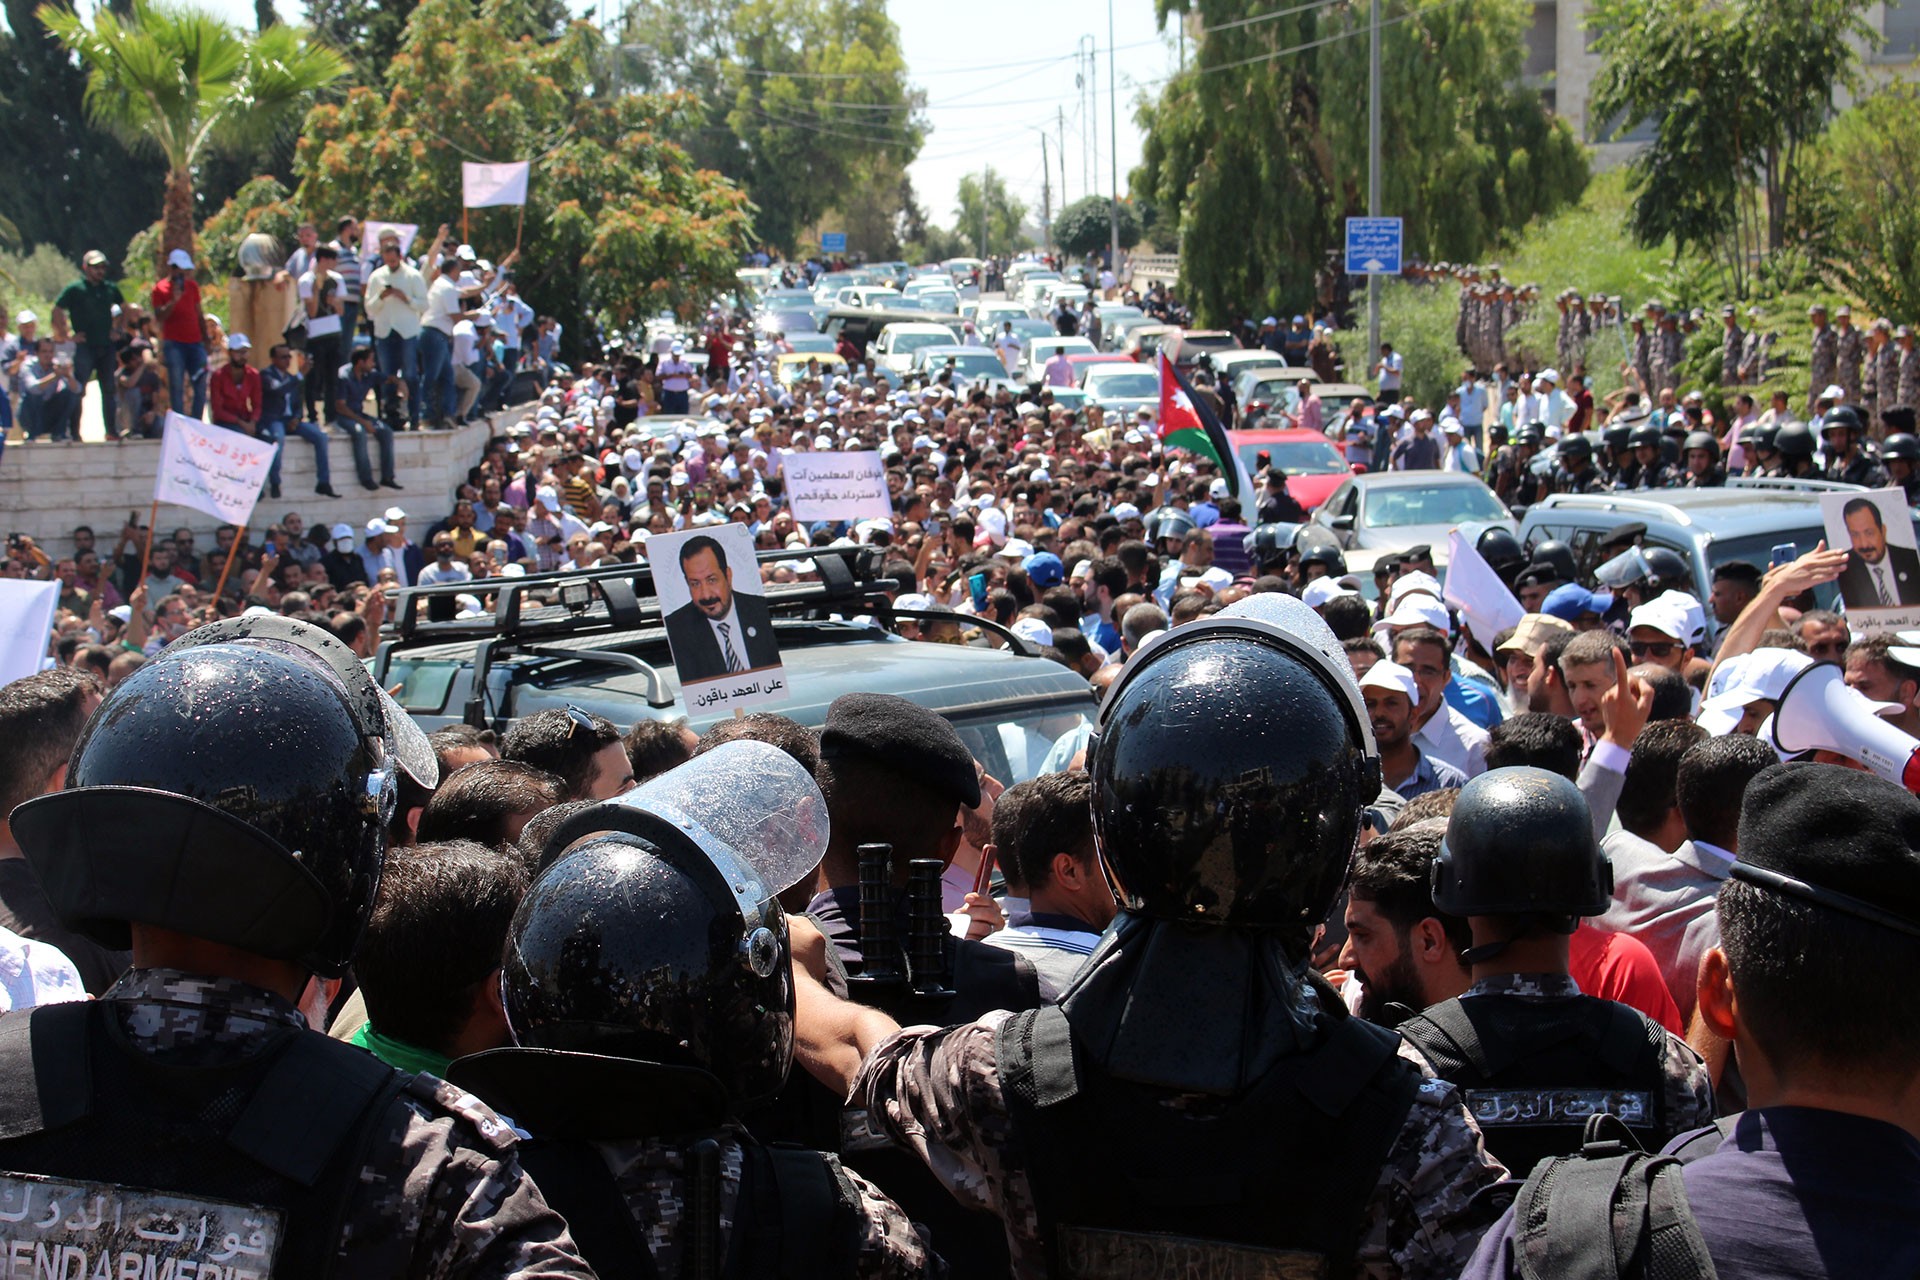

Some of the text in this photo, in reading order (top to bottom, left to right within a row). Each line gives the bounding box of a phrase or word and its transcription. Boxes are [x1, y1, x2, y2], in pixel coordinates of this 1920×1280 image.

[808, 470, 854, 483] المعلمين
[794, 488, 839, 504] حقوقهم
[731, 682, 761, 698] العهد
[763, 679, 783, 694] على
[1476, 1094, 1643, 1121] قوات الدرك
[0, 1182, 267, 1262] قوات الدرك
